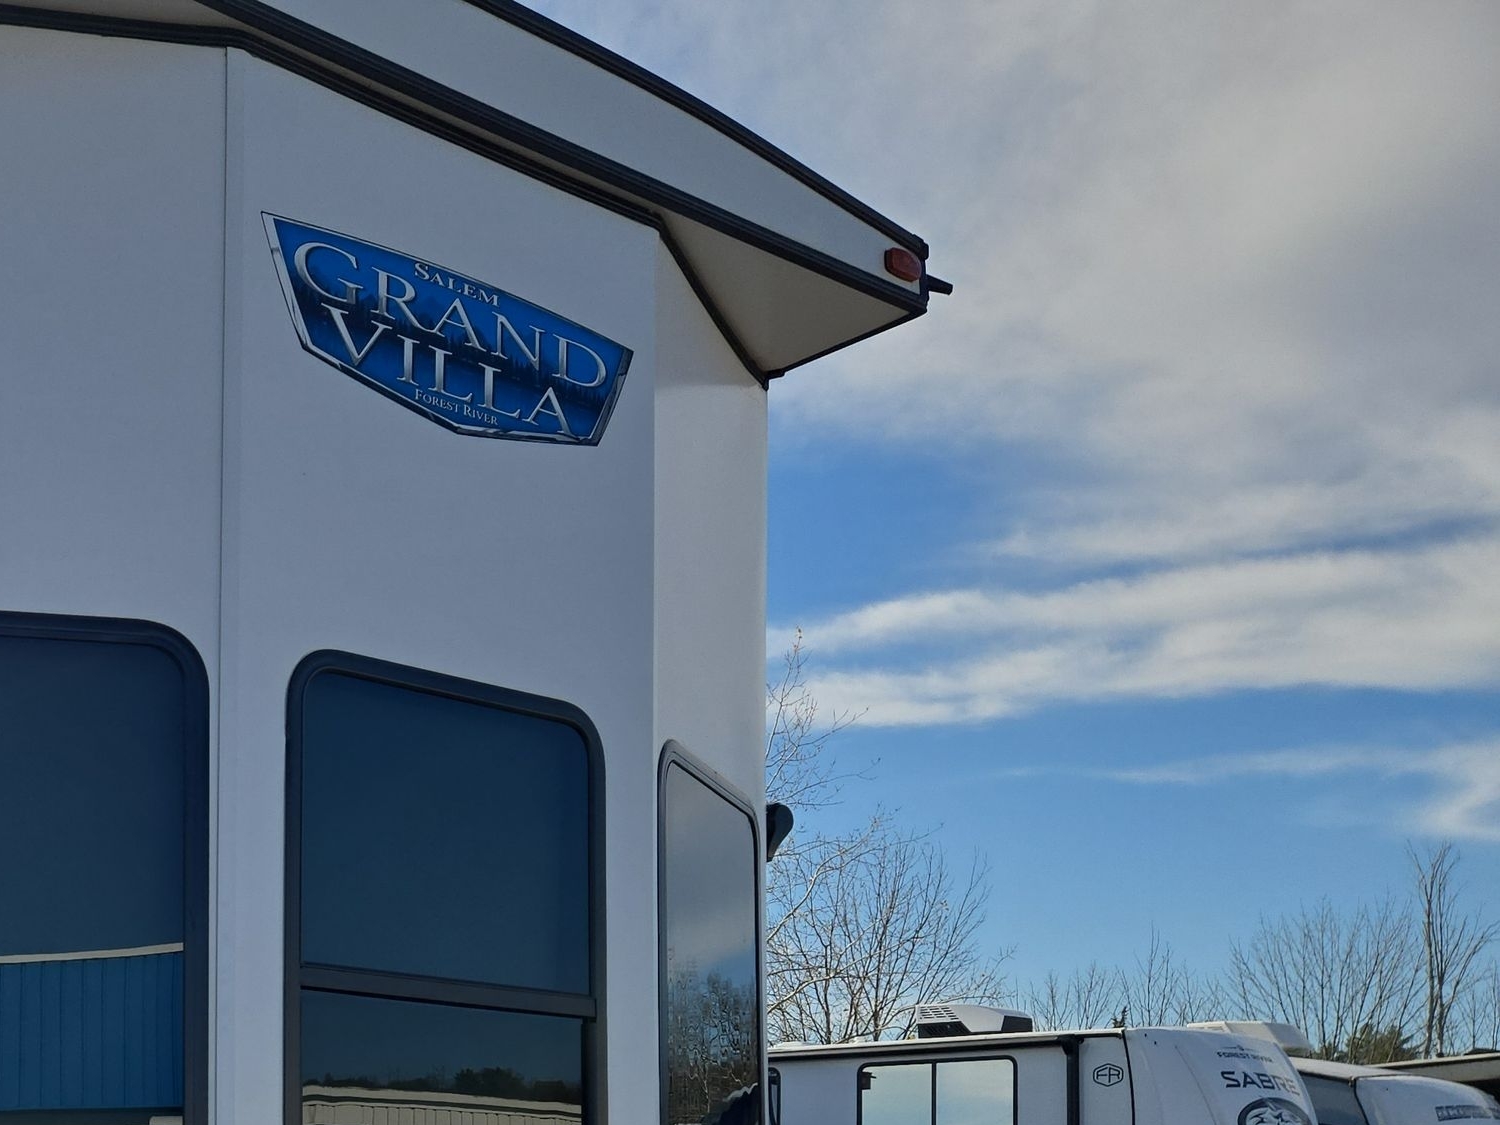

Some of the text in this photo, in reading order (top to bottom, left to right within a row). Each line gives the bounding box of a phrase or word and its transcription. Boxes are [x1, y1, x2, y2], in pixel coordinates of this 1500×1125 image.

[414, 262, 499, 308] SALEM
[294, 242, 607, 388] GRAND
[321, 302, 581, 440] VILLA
[415, 388, 499, 426] FOREST RIVER
[1220, 1071, 1300, 1096] SABRE
